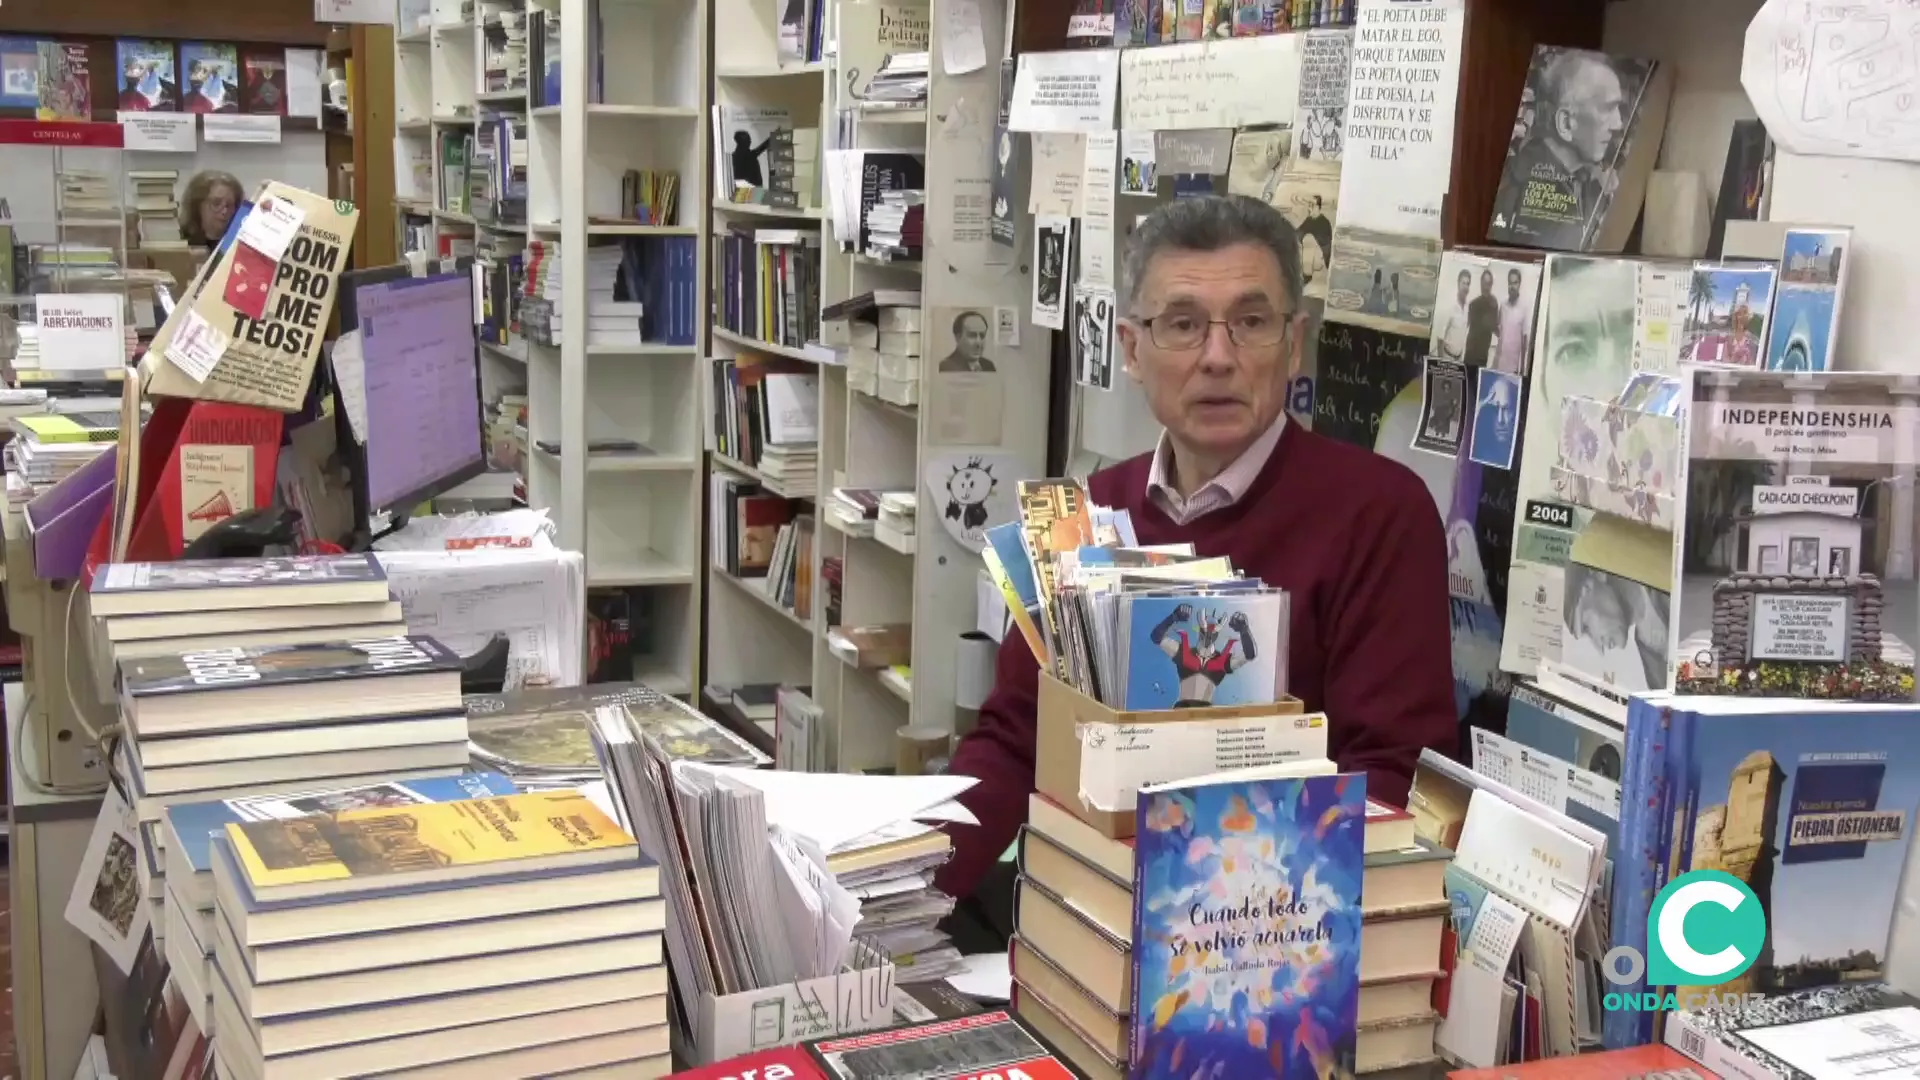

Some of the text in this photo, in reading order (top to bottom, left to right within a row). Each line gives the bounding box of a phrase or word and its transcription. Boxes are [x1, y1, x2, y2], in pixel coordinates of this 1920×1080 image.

[1383, 9, 1416, 22] POETA
[1420, 8, 1447, 22] DEBE
[1361, 28, 1442, 43] MATAR EL EGO,
[1354, 48, 1445, 64] PORQUE TAMBIEN
[1355, 67, 1440, 83] ES POETA QUIEN
[1355, 87, 1373, 100] LEE
[1420, 89, 1434, 103] LA
[1353, 105, 1431, 123] DISFRUTA Y SE
[1348, 125, 1432, 142] IDENTIFICA CON
[1528, 181, 1556, 192] TODOS
[1525, 188, 1577, 204] LOS POEMAS
[313, 228, 342, 244] HESSEL
[275, 263, 329, 299] PRO
[275, 293, 322, 330] ME
[43, 316, 112, 328] ABREVIACIONES
[1722, 409, 1893, 428] INDEPENDENSHIA
[1758, 492, 1855, 506] CADI-CADI CHECKPOINT
[1531, 505, 1568, 524] 2004
[1793, 815, 1900, 838] PIEDRA OSTIONERA
[1532, 847, 1562, 868] mayo
[1189, 892, 1308, 926] Cuando todo
[1171, 921, 1332, 956] se volvió acuarela
